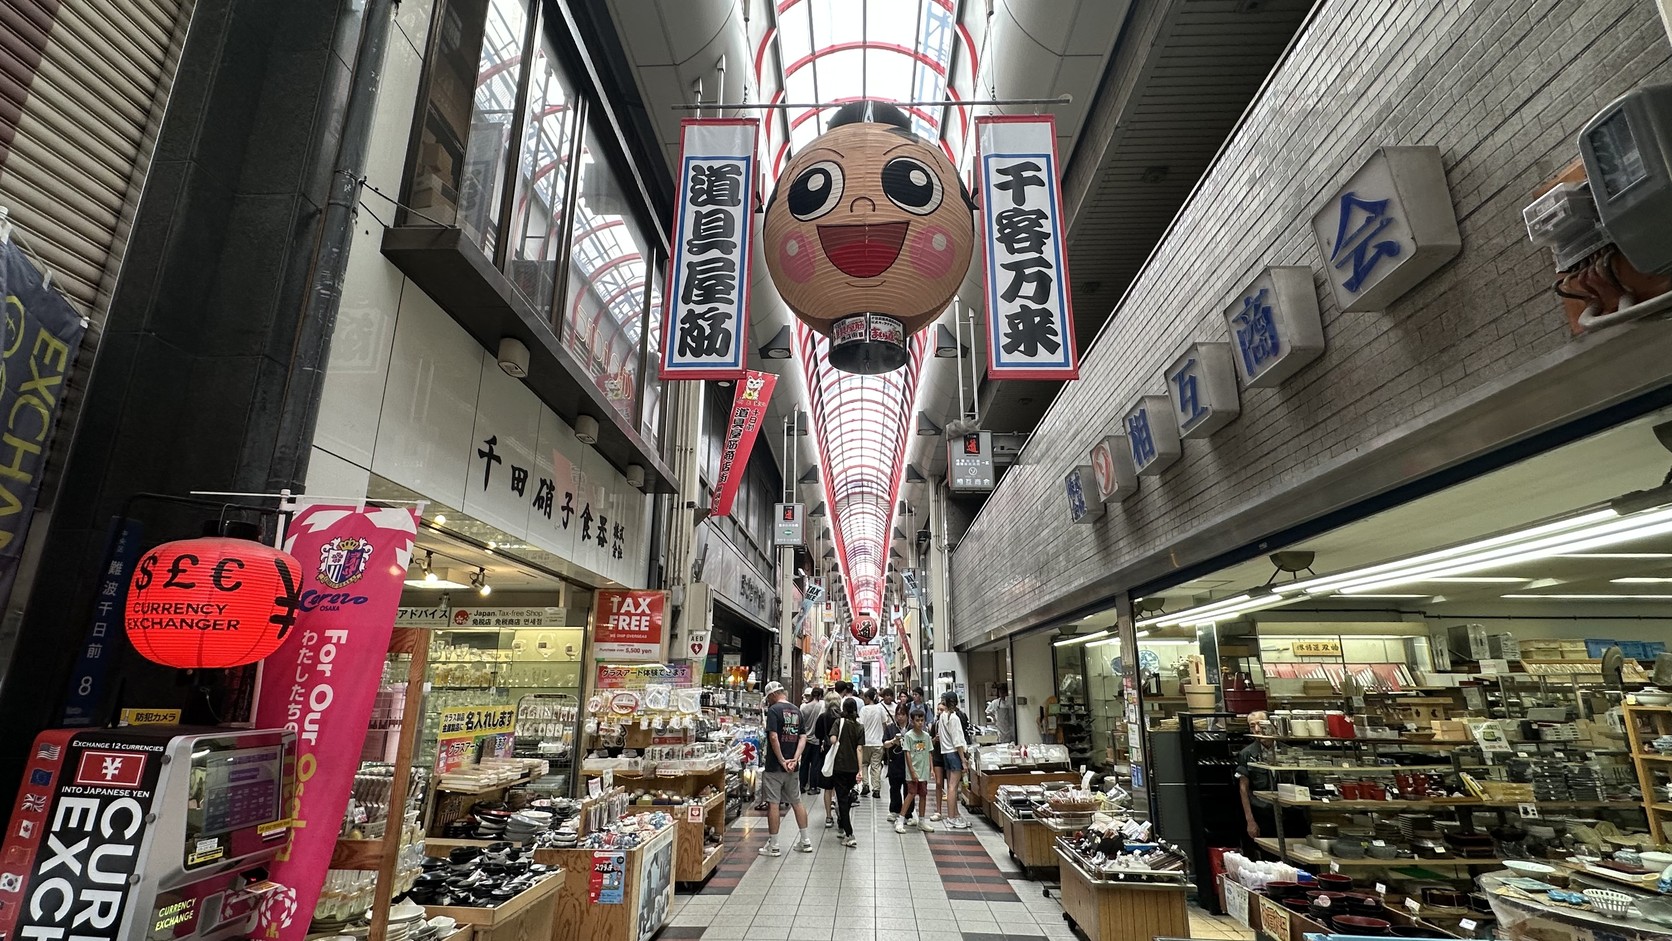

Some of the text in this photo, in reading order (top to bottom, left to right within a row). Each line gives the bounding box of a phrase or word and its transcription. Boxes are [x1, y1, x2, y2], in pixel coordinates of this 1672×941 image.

[678, 163, 741, 357] 道具屋筋
[994, 161, 1061, 357] 千客万来
[1128, 192, 1400, 466] 相互商会
[478, 435, 608, 548] 千田硝子食器
[87, 561, 124, 659] 難波千日前
[133, 602, 228, 615] CURRENCY
[300, 590, 368, 612] Cerezo
[611, 596, 652, 614] TAX
[127, 617, 240, 631] EXCHANGER
[396, 609, 448, 619] アドバイス
[526, 610, 543, 618] Shop
[609, 615, 650, 631] FREE
[856, 620, 873, 639] 道
[317, 629, 348, 677] For
[79, 676, 92, 695] 8
[284, 629, 318, 734] わたしたちの
[135, 712, 176, 722] 防犯カメラ
[302, 684, 333, 746] Our
[466, 710, 514, 732] 名入れします
[73, 740, 110, 749] EXCHANGE
[122, 743, 164, 752] CURRENCIES
[62, 786, 150, 798] INTO JAPANESE YEN
[72, 797, 142, 941] CUR
[159, 898, 197, 917] CURRENCY
[155, 910, 194, 931] EXCHANGE
